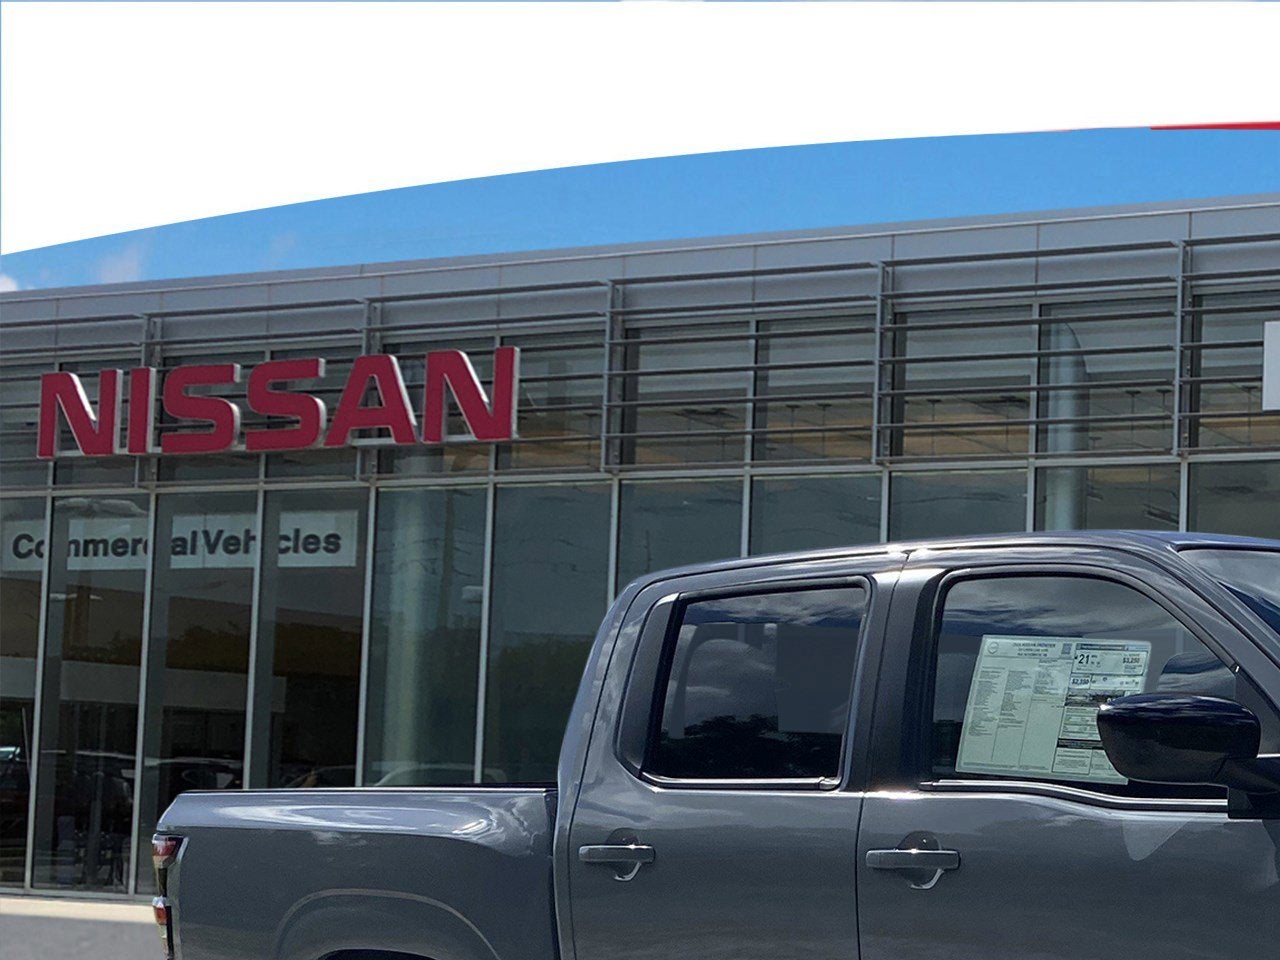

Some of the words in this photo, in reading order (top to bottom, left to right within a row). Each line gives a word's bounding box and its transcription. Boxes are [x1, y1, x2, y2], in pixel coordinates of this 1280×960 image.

[37, 346, 520, 458] NISSAN
[12, 530, 198, 560] Comeral
[202, 528, 342, 556] Vehcles
